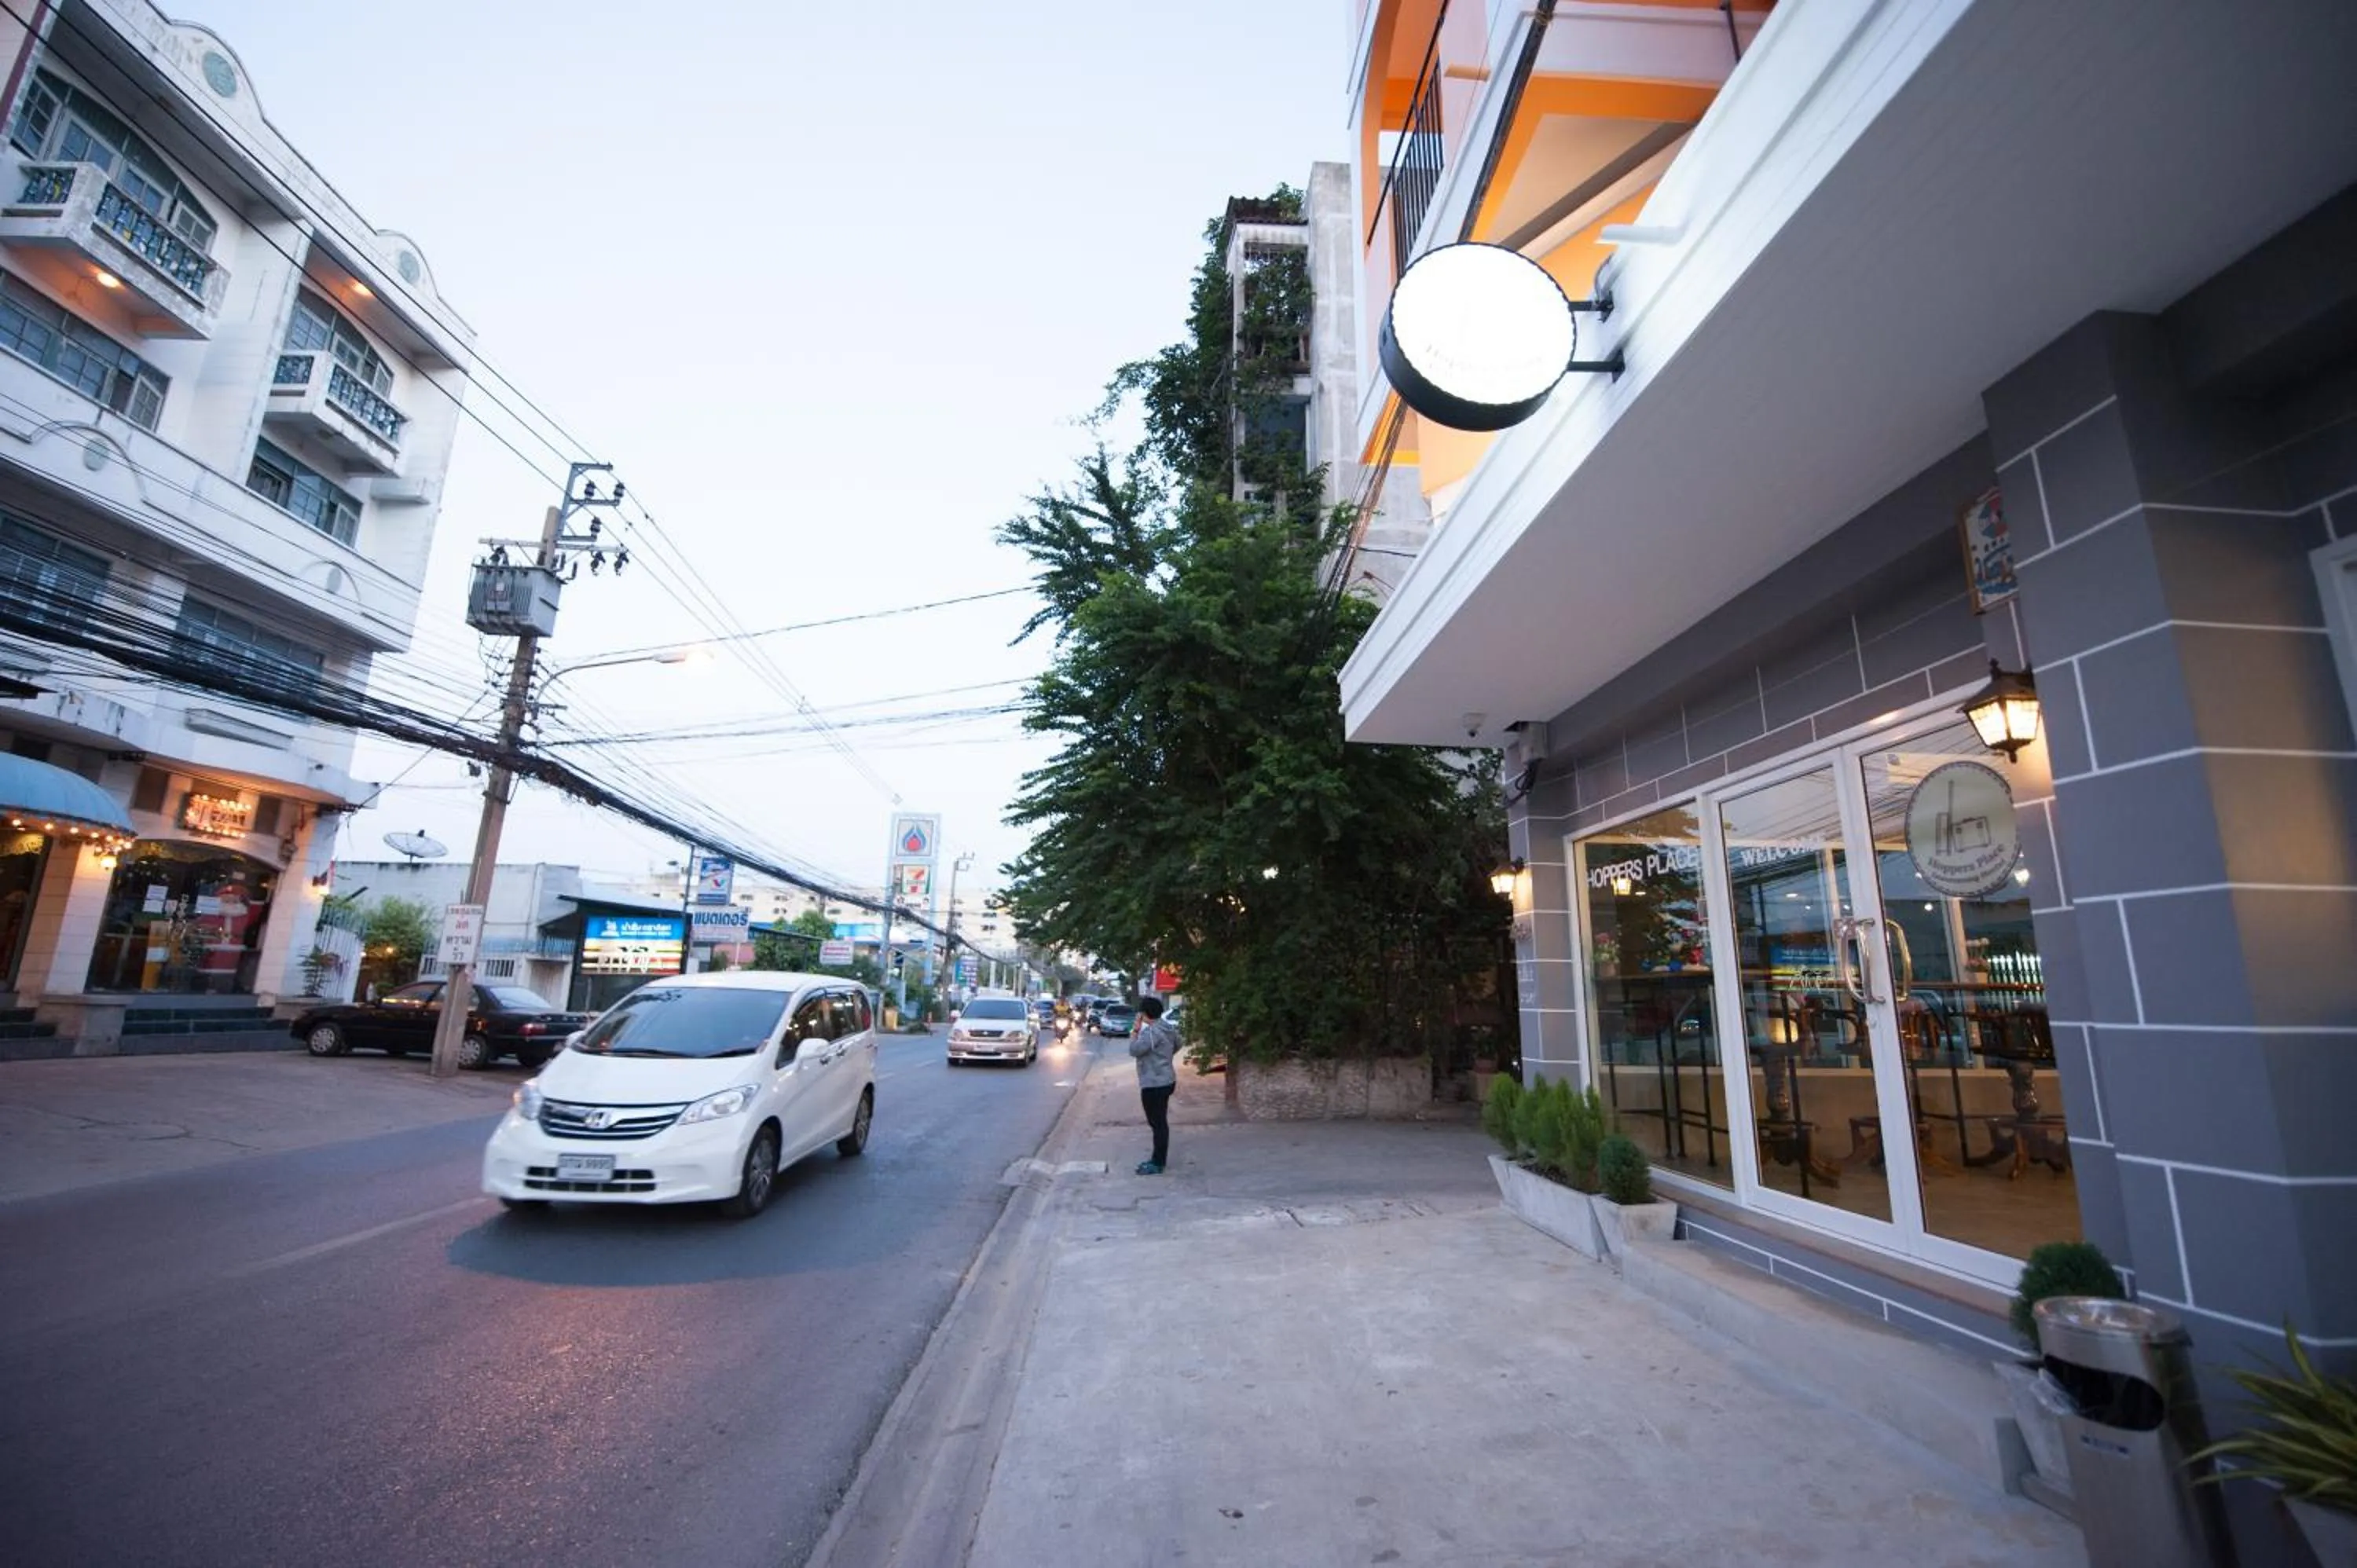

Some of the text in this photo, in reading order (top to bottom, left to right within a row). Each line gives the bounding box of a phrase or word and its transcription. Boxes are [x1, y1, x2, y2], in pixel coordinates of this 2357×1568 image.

[1586, 846, 1699, 888] HOPPERS PLACE
[1927, 844, 2004, 876] Hoppers Place
